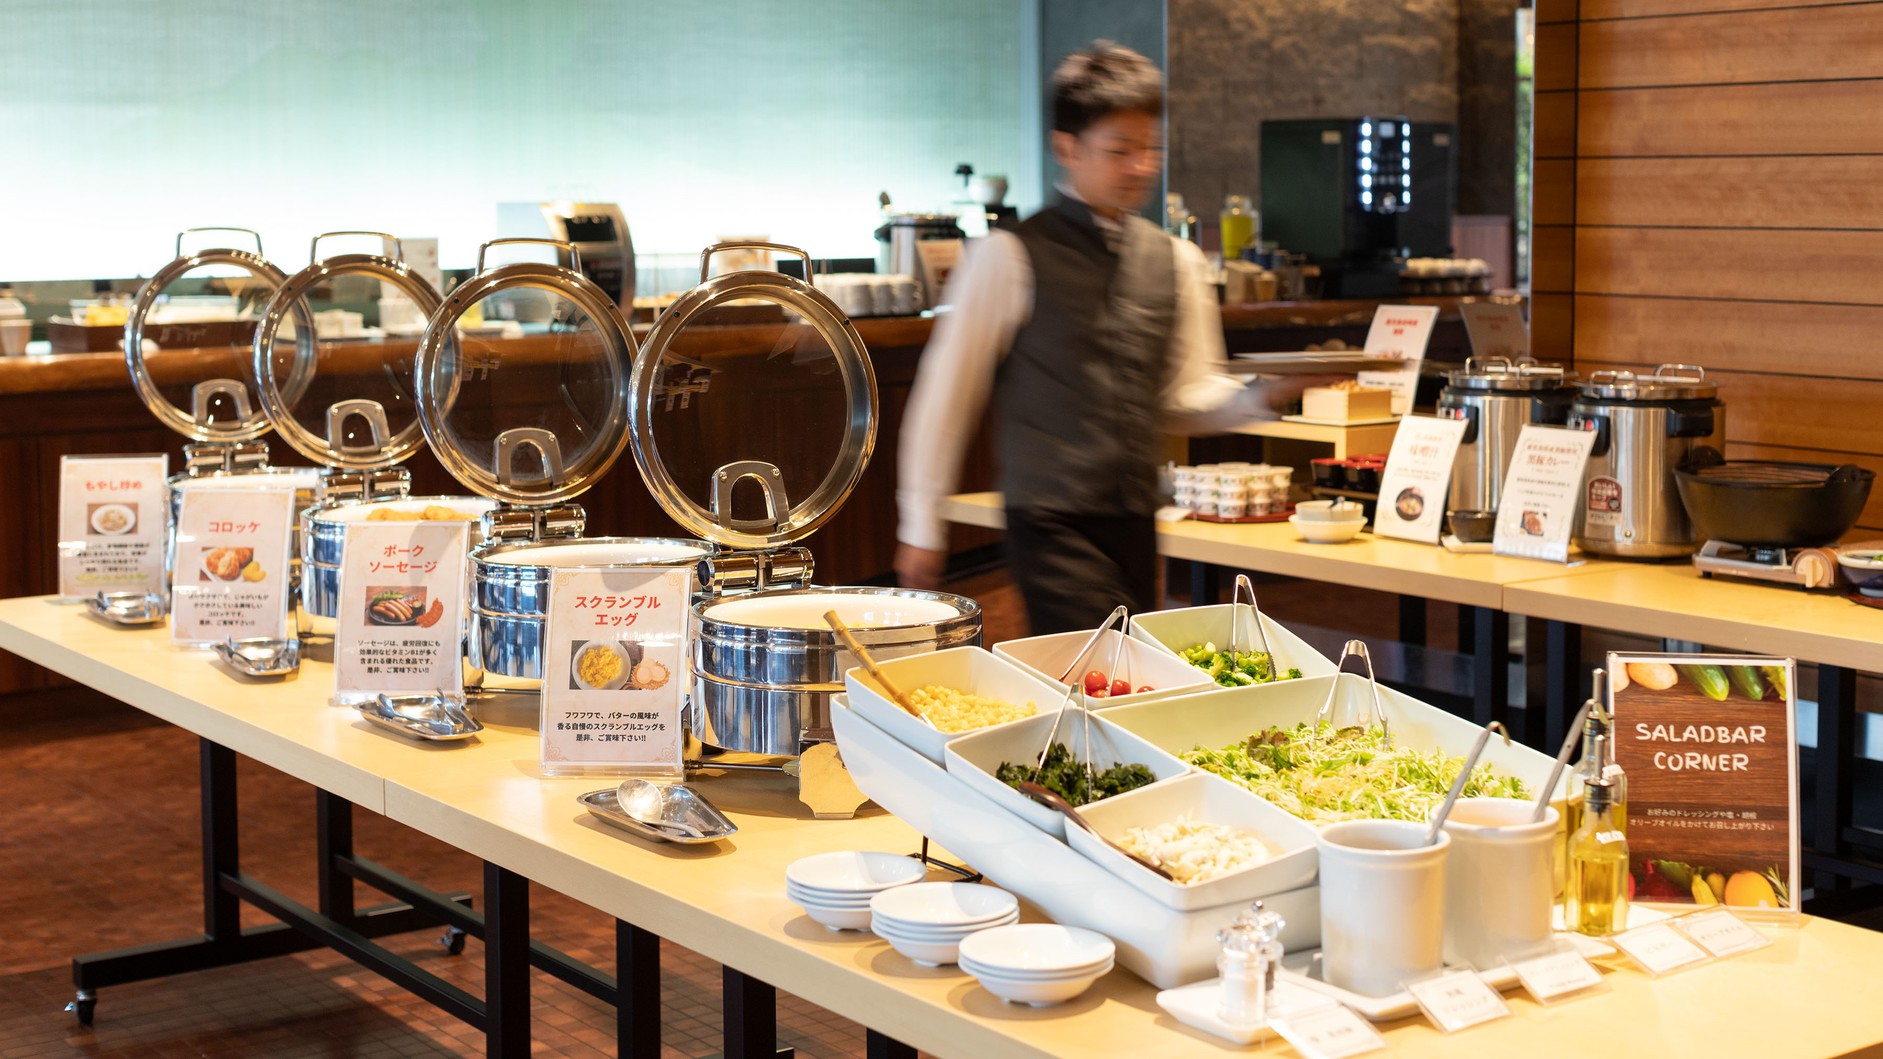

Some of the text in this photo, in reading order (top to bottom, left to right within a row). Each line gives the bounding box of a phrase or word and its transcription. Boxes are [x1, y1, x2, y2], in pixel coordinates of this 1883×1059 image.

[85, 480, 142, 492] もやし炒め
[208, 521, 260, 534] コロッケ
[369, 560, 438, 573] ソーセージ
[574, 595, 662, 609] スクランブル
[594, 612, 639, 627] エッグ
[564, 711, 659, 720] フワフワで、バターの風味が
[557, 722, 666, 731] 香る自慢のスクランブルエッグを
[1635, 723, 1766, 744] SALADBAR
[1654, 751, 1749, 771] CORNER
